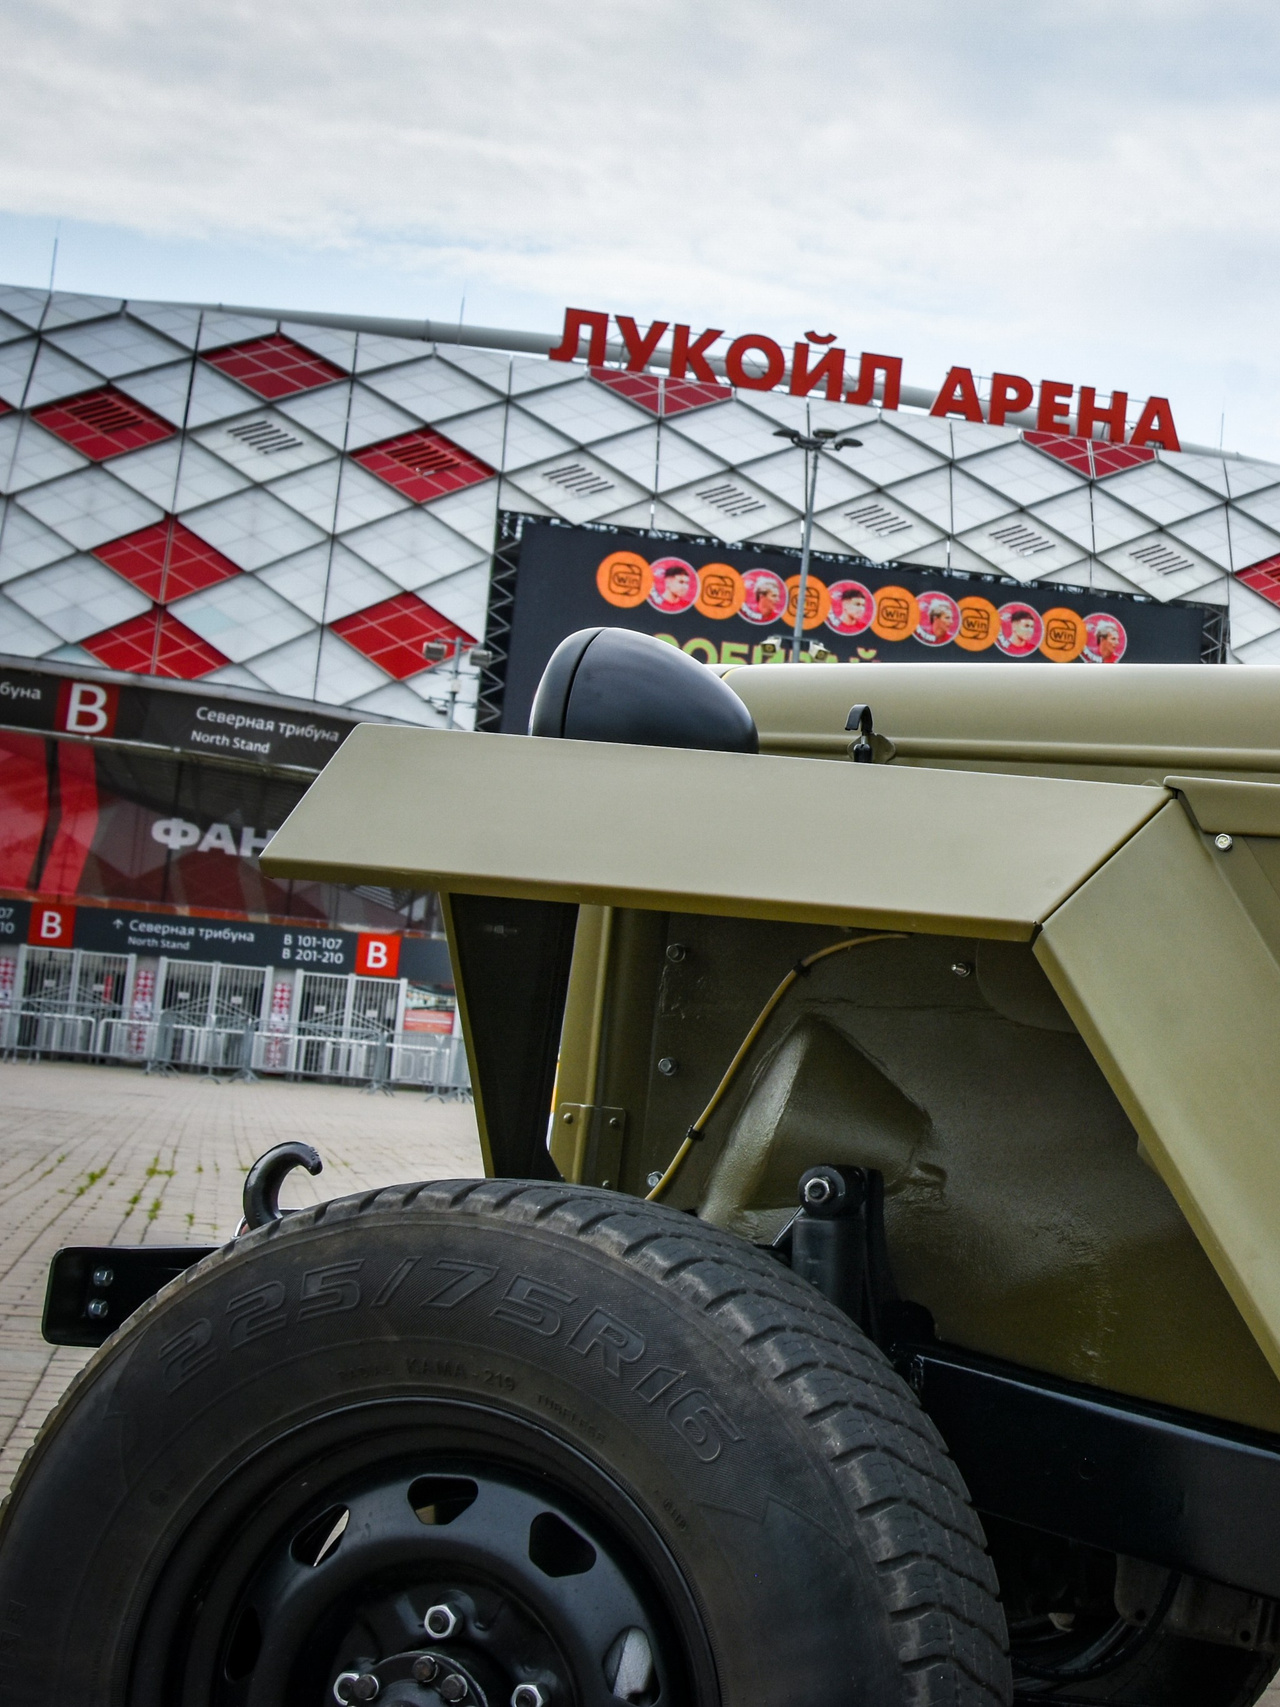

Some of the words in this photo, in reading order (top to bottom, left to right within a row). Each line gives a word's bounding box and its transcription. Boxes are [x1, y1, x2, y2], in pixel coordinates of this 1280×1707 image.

[549, 307, 903, 411] ЛУКОЙЛ
[929, 364, 1181, 453] АРЕНА
[195, 705, 275, 731] Северная
[277, 719, 341, 743] трибуна
[191, 730, 230, 749] North
[232, 734, 271, 754] Stand
[127, 936, 159, 948] North
[160, 938, 190, 950] Stand
[128, 919, 195, 937] Северная
[198, 926, 255, 944] трибуна
[297, 934, 343, 950] 101-107
[295, 948, 344, 965] 201-210
[155, 1255, 747, 1465] 225/75R16
